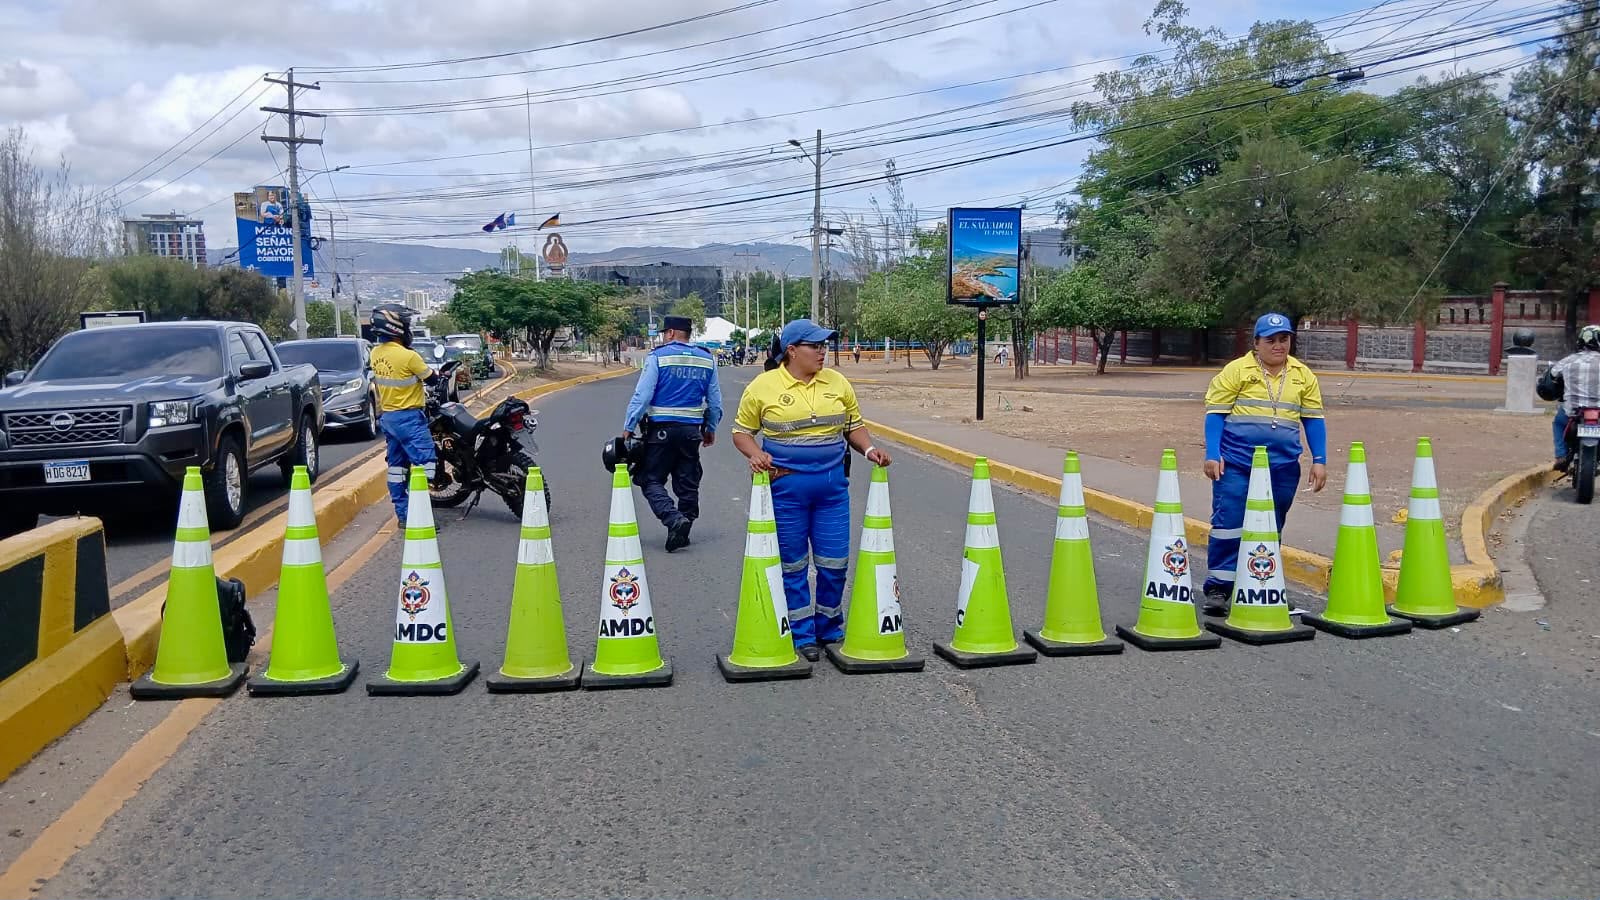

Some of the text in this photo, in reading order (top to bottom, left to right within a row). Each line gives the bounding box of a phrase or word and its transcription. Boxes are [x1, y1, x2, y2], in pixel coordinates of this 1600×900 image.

[255, 226, 293, 235] MEJOR
[959, 221, 1013, 230] EL SALVADOR
[256, 236, 293, 246] SEÑAL
[257, 247, 294, 256] MAYOR
[671, 367, 706, 380] POLICA
[65, 465, 88, 478] 8217
[599, 616, 654, 637] AMDC
